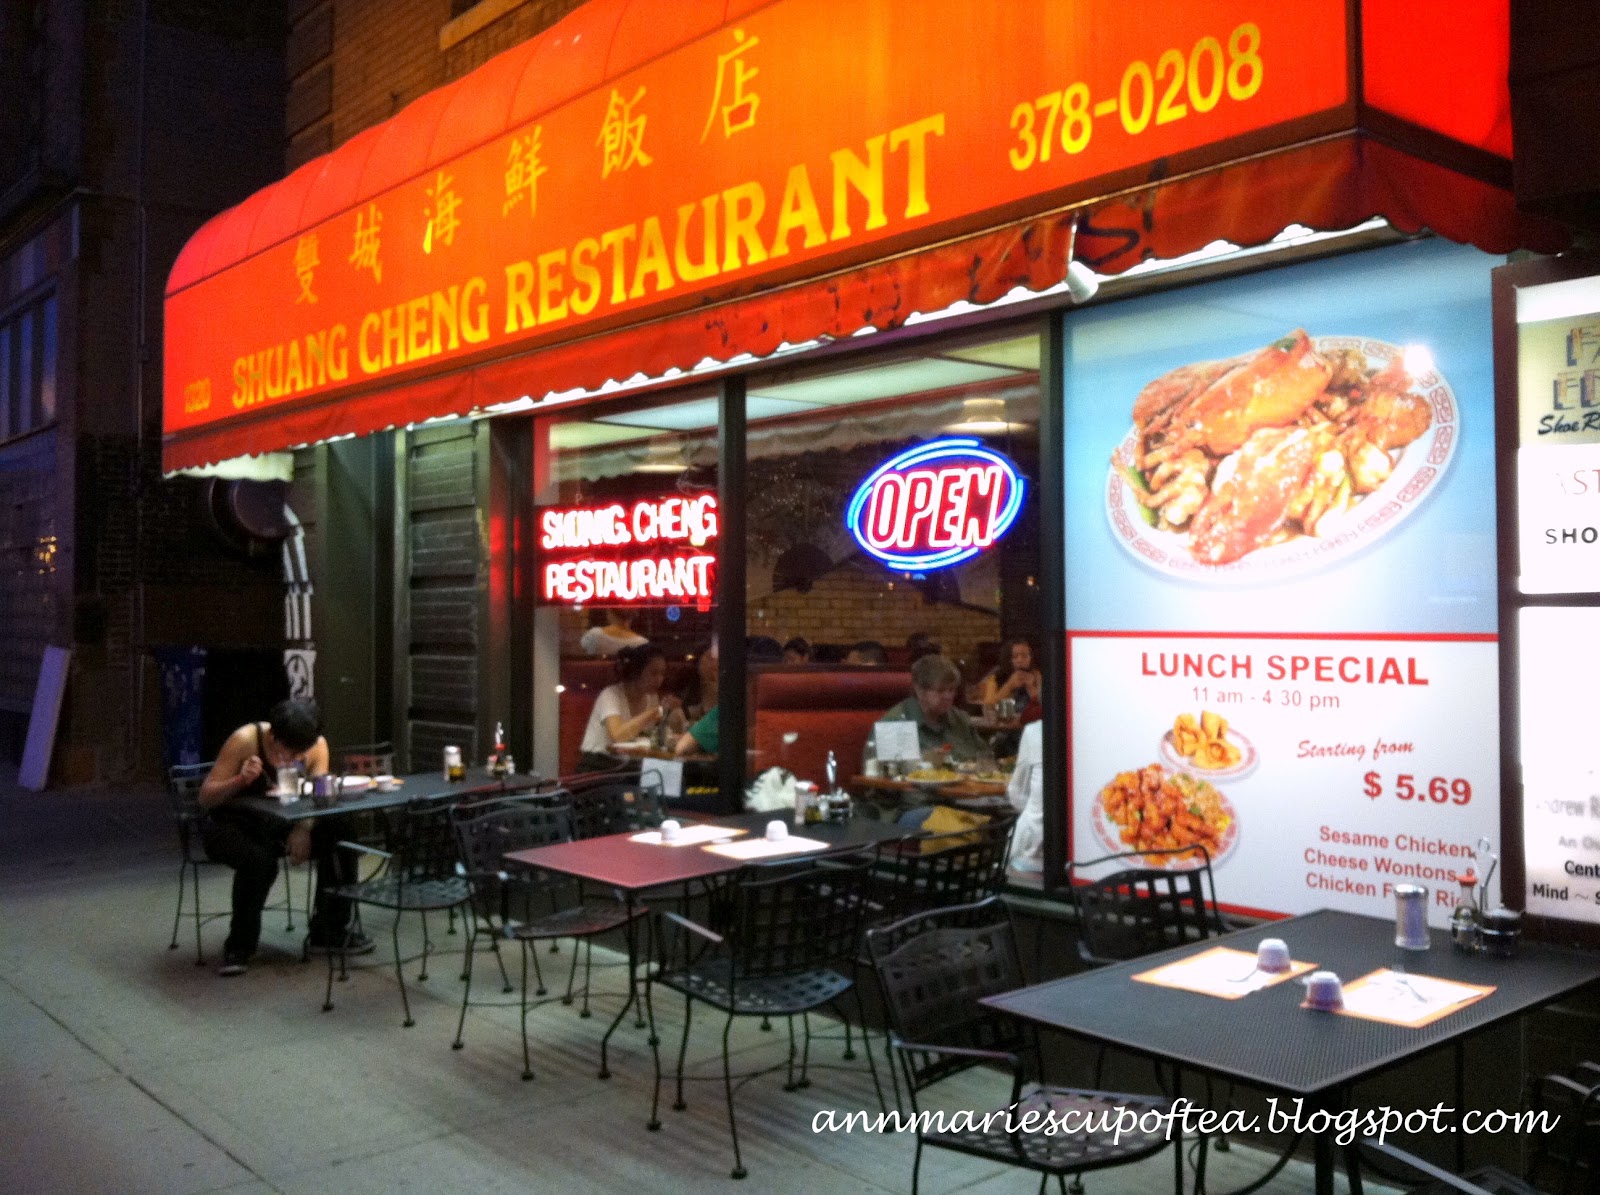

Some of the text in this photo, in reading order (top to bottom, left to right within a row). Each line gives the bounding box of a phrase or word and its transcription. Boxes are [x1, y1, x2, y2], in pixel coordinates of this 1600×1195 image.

[1008, 22, 1265, 172] 378-0208
[231, 323, 350, 409] SHUANG
[357, 276, 491, 375] CHENG
[503, 112, 946, 335] RESTAURANT
[1538, 412, 1580, 435] Shoe
[633, 494, 718, 546] CHENG
[867, 465, 1003, 548] OPEN
[545, 555, 716, 603] RESTAURANT
[1141, 651, 1430, 686] LUNCH SPECIAL
[1192, 686, 1209, 702] 11
[1216, 690, 1243, 703] am
[1309, 693, 1340, 711] pm
[1297, 737, 1415, 761] Starting from
[1395, 774, 1472, 806] 5.69
[1319, 825, 1389, 850] Sesame
[1304, 847, 1369, 871] Cheese
[1374, 856, 1457, 882] Wontons
[1306, 872, 1376, 897] Chicken
[1533, 882, 1569, 901] Mind
